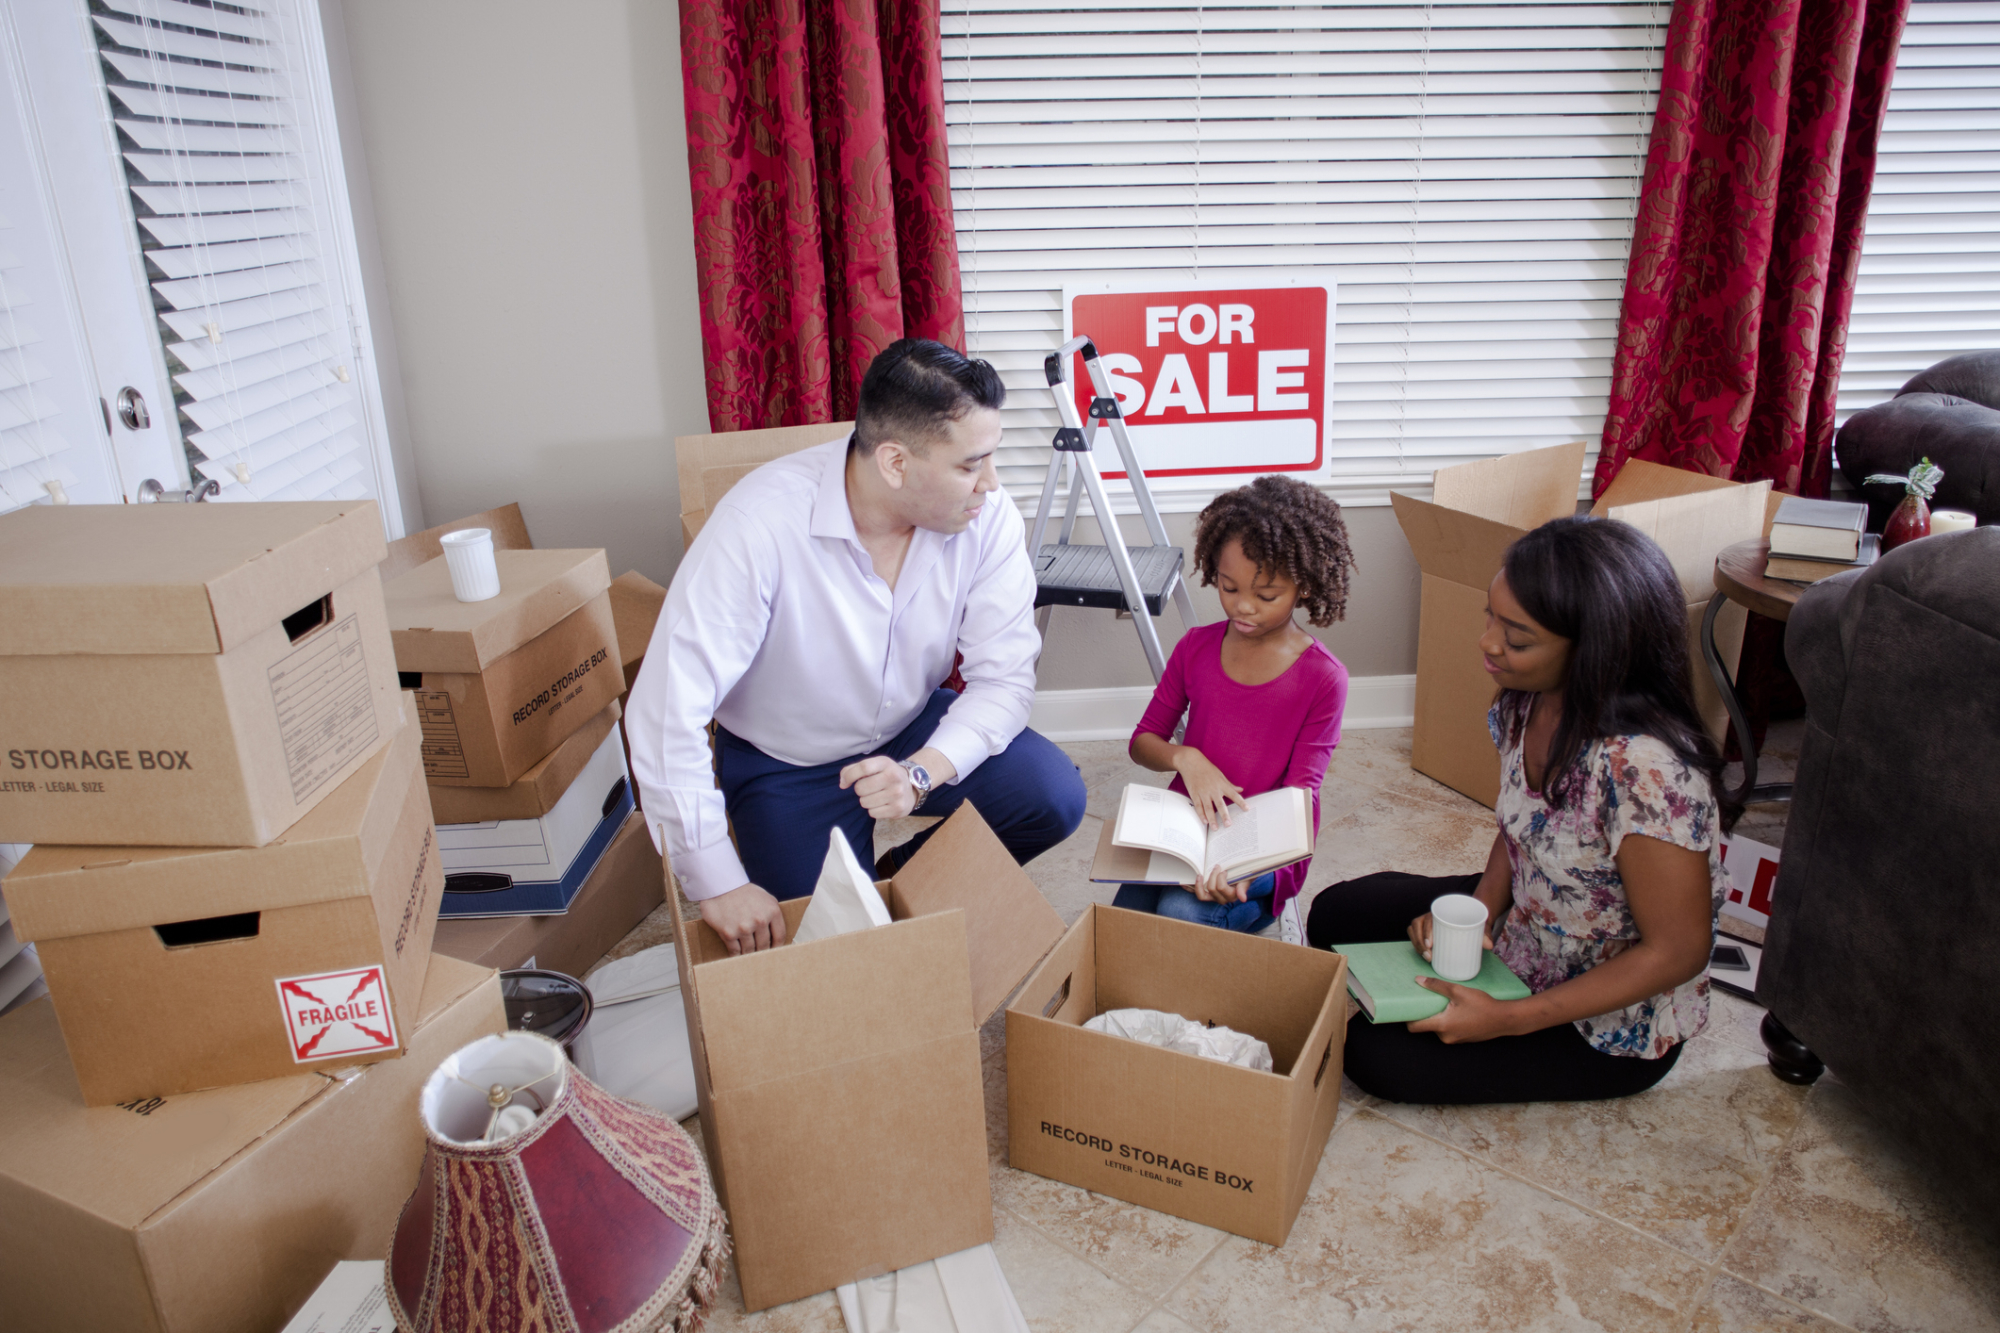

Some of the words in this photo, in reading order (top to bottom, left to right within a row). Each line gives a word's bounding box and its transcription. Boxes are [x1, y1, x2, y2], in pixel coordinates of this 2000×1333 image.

[1146, 303, 1255, 347] FOR
[1091, 349, 1310, 416] SALE
[512, 690, 550, 726] RECORD
[551, 659, 591, 697] STORAGE
[590, 647, 608, 668] BOX
[8, 749, 133, 770] STORAGE
[138, 750, 193, 770] BOX
[45, 782, 80, 793] LEGAL
[81, 782, 105, 793] SIZE
[298, 1000, 378, 1026] FRAGILE
[1041, 1121, 1113, 1152] RECORD
[1119, 1144, 1209, 1180] STORAGE
[1214, 1170, 1254, 1193] BOX
[1105, 1159, 1133, 1173] LETTER
[1140, 1169, 1164, 1182] LEGAL
[1166, 1176, 1183, 1188] SIZE
